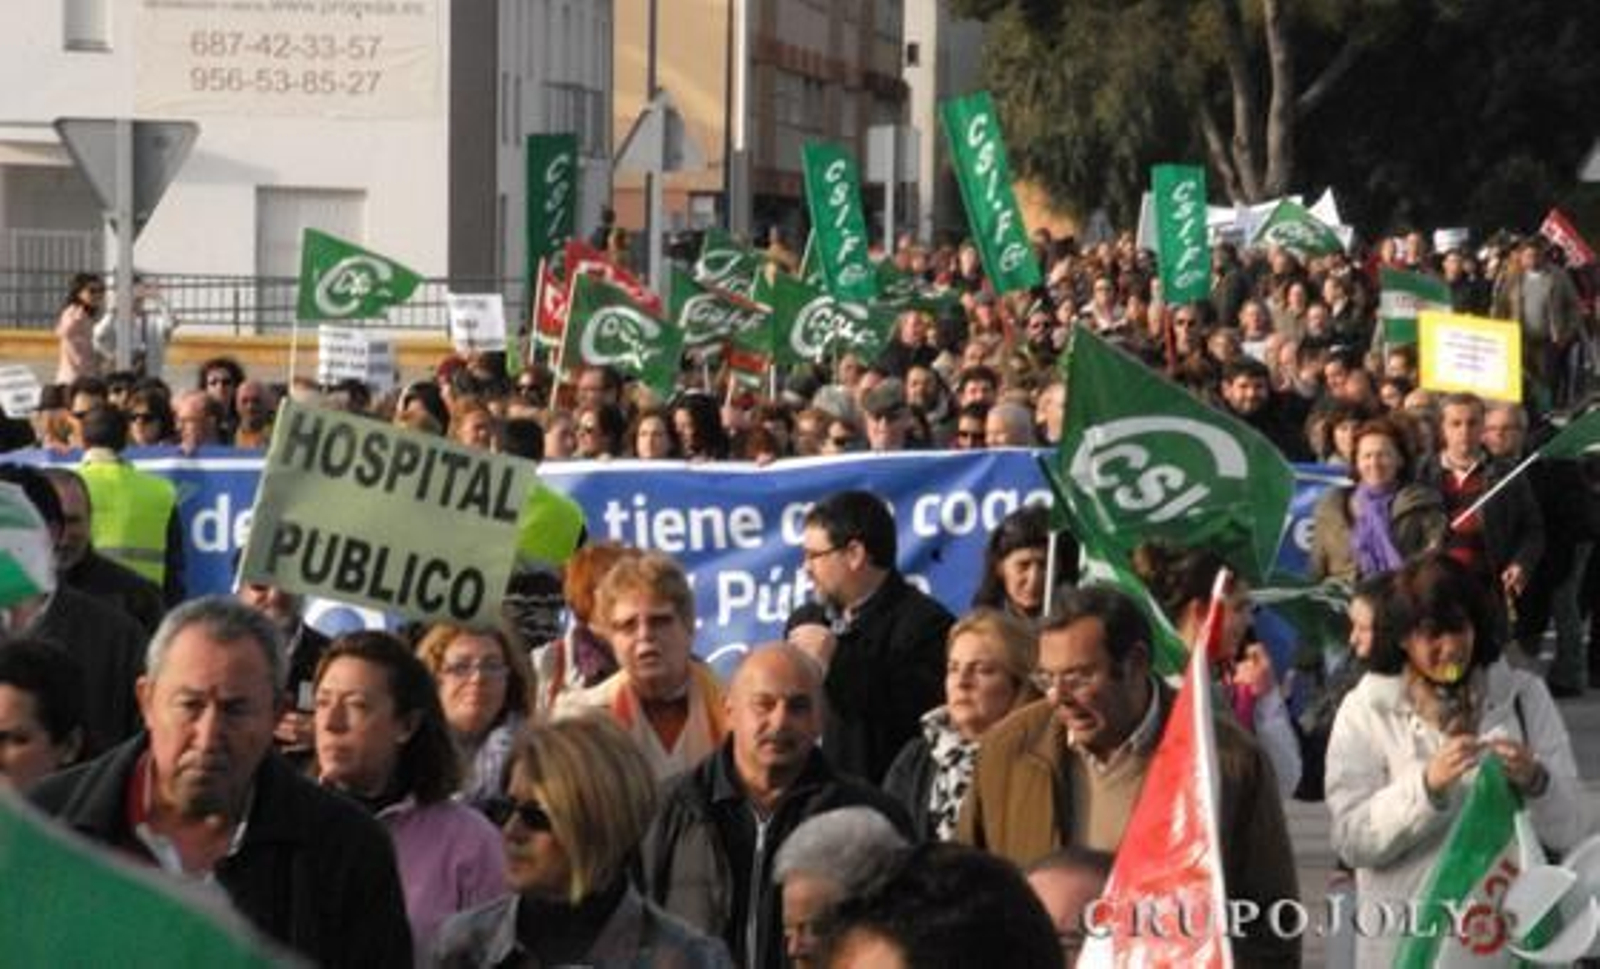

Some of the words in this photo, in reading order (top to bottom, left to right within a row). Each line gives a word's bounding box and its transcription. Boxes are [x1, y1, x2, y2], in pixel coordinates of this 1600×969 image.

[189, 31, 383, 60] 687-42-33-57
[189, 67, 382, 95] 956-53-85-27
[281, 412, 519, 523] HOSPITAL
[604, 492, 764, 552] tiene
[265, 520, 486, 621] PUBLICO
